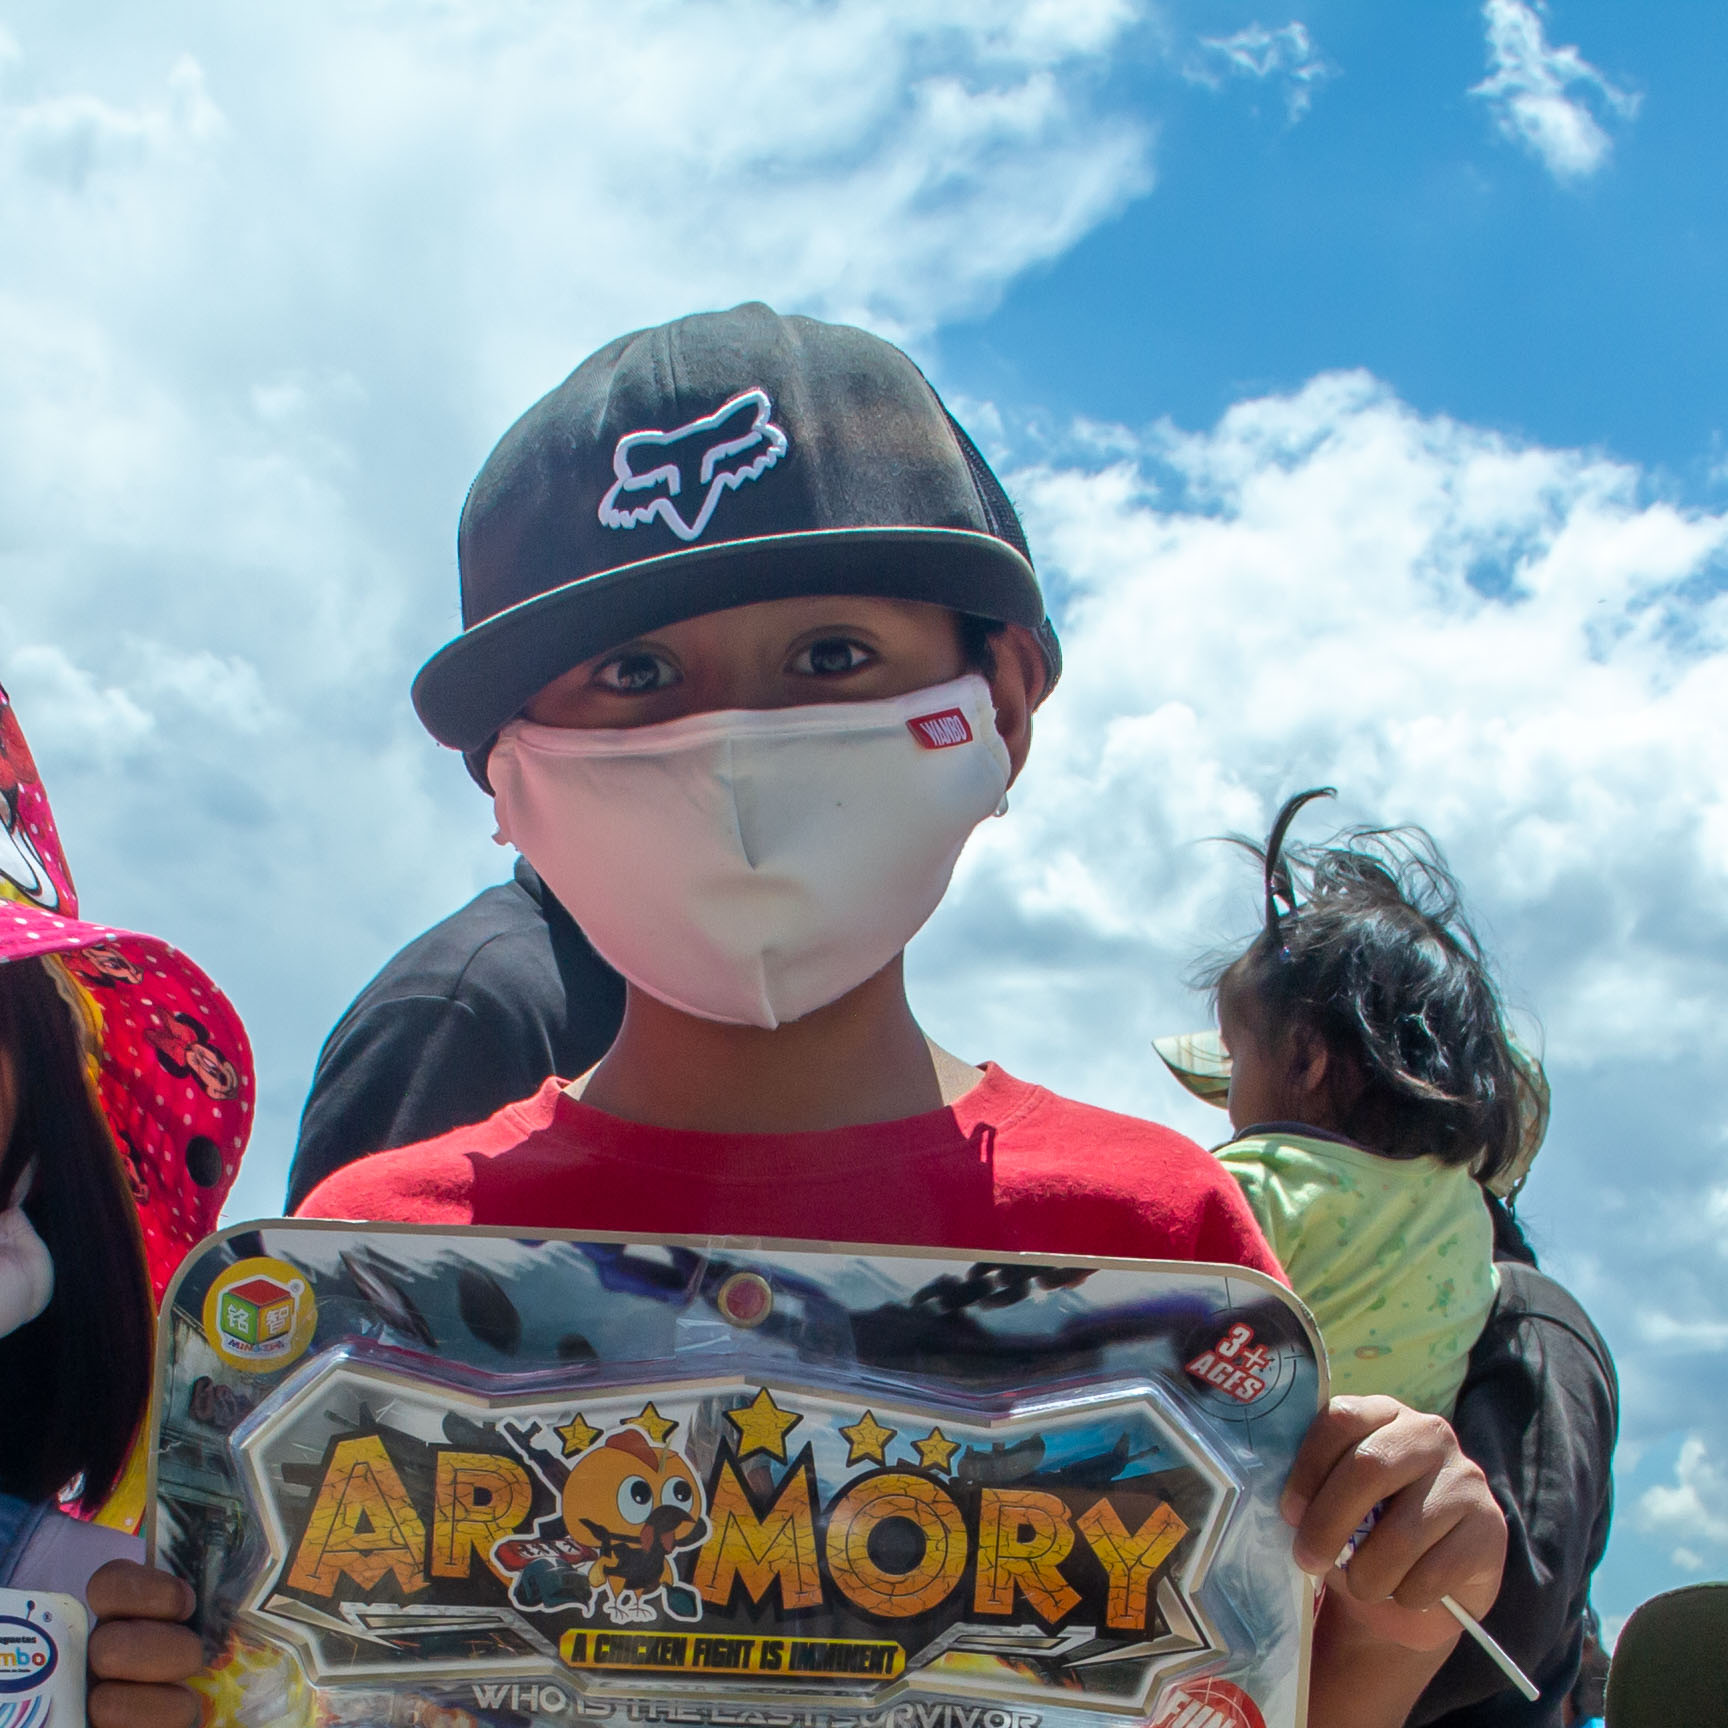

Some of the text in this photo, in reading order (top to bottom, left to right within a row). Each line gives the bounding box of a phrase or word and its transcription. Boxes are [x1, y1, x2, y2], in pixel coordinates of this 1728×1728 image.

[1219, 1326, 1266, 1368] 3+
[571, 1632, 899, 1675] A CHICKEN FIGHT IS IMMINENT
[474, 1684, 568, 1713] WHO
[578, 1697, 615, 1719] IS
